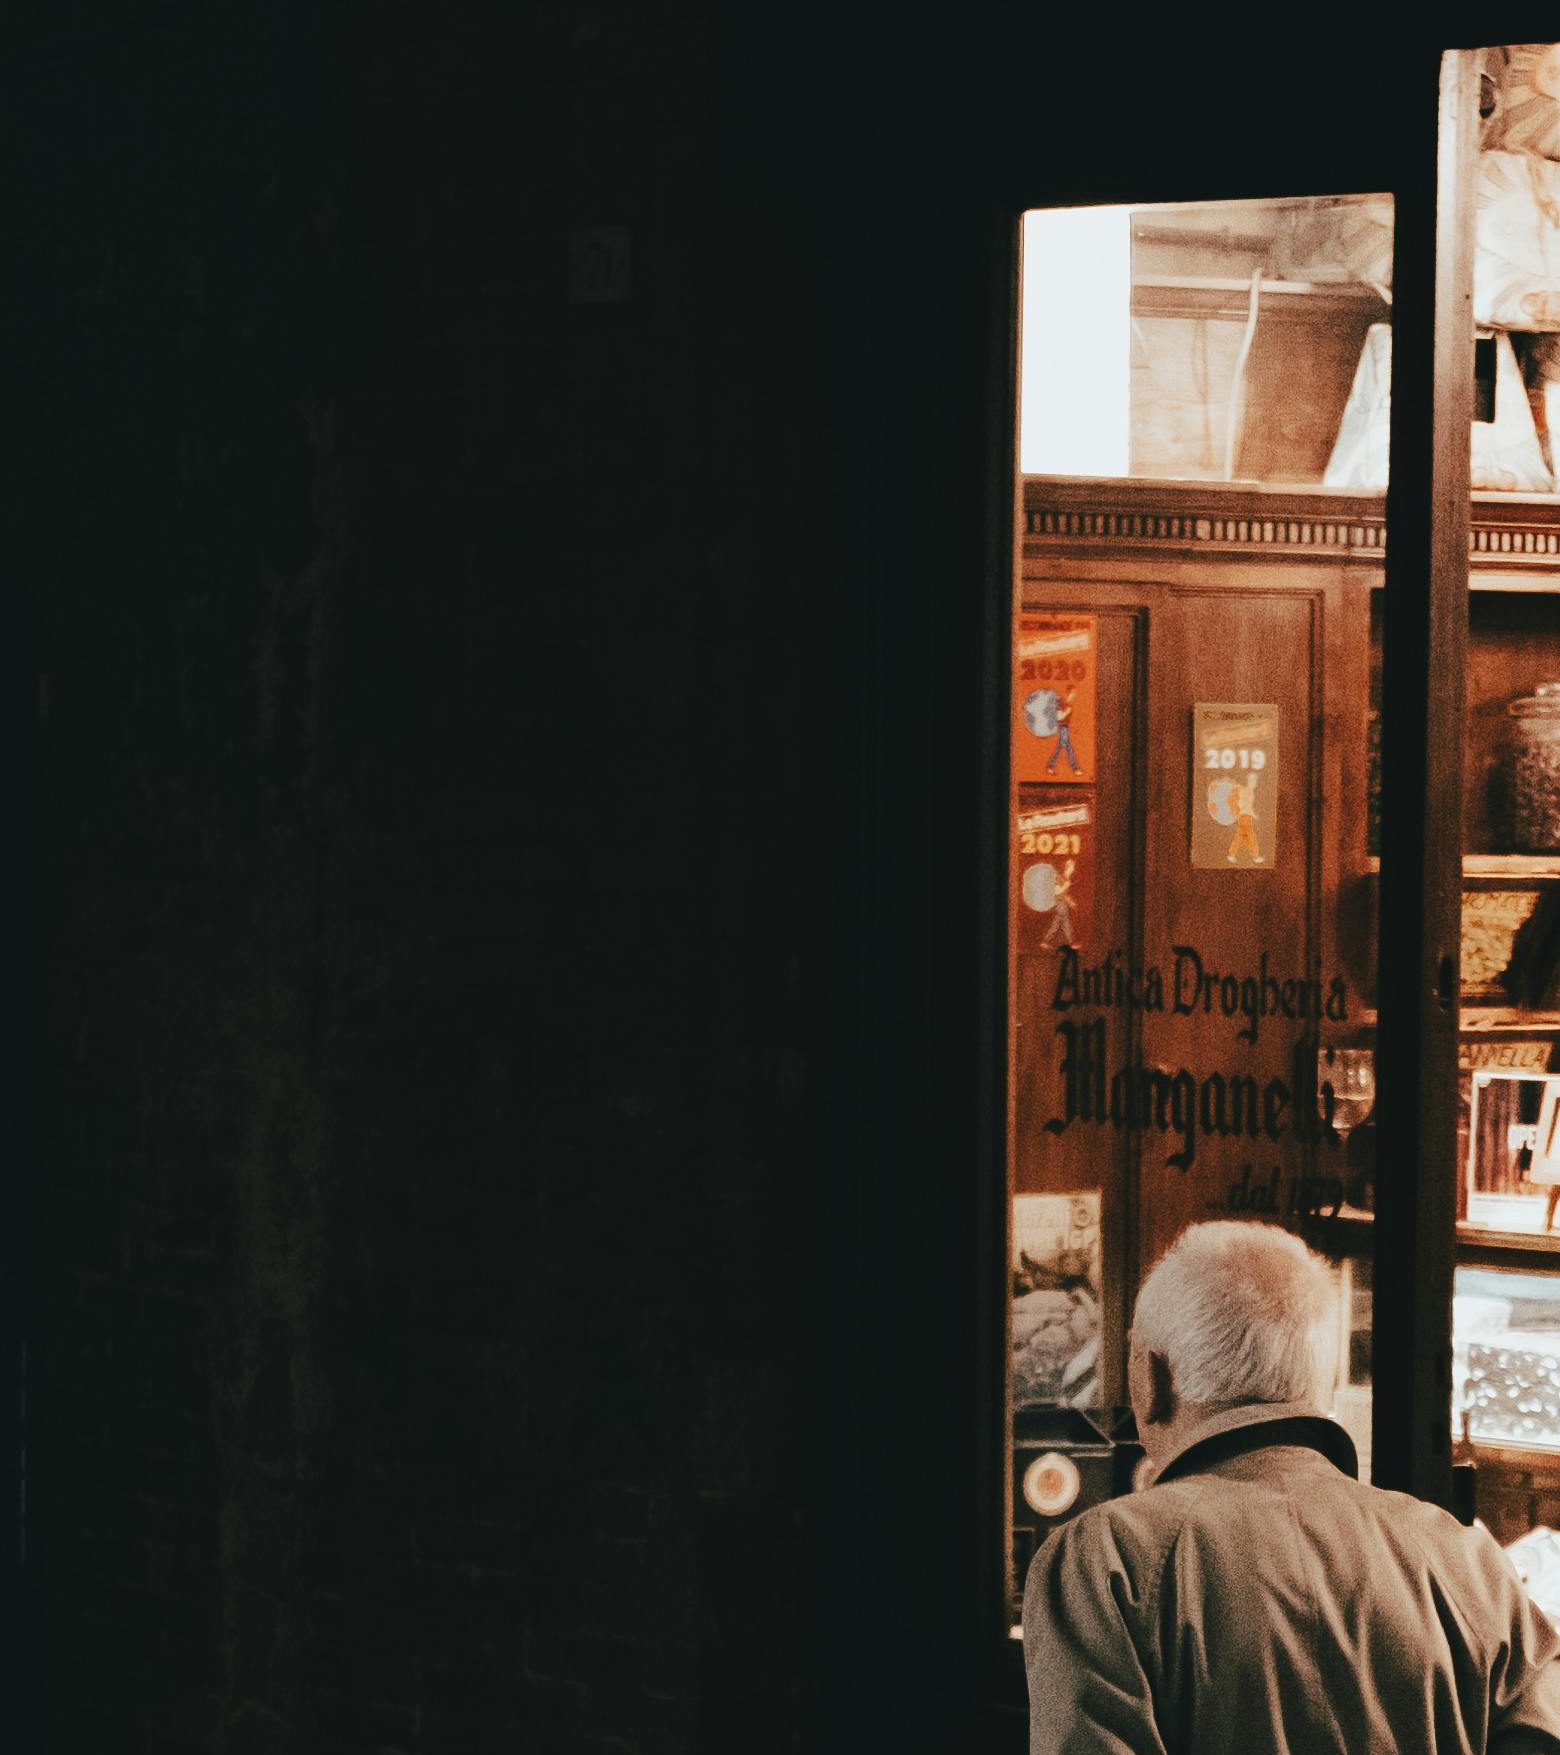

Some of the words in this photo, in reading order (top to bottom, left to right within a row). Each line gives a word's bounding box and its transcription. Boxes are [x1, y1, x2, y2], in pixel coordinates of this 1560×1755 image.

[1020, 660, 1087, 682] 2020
[1204, 749, 1267, 770] 2019
[1021, 834, 1081, 855] 2021
